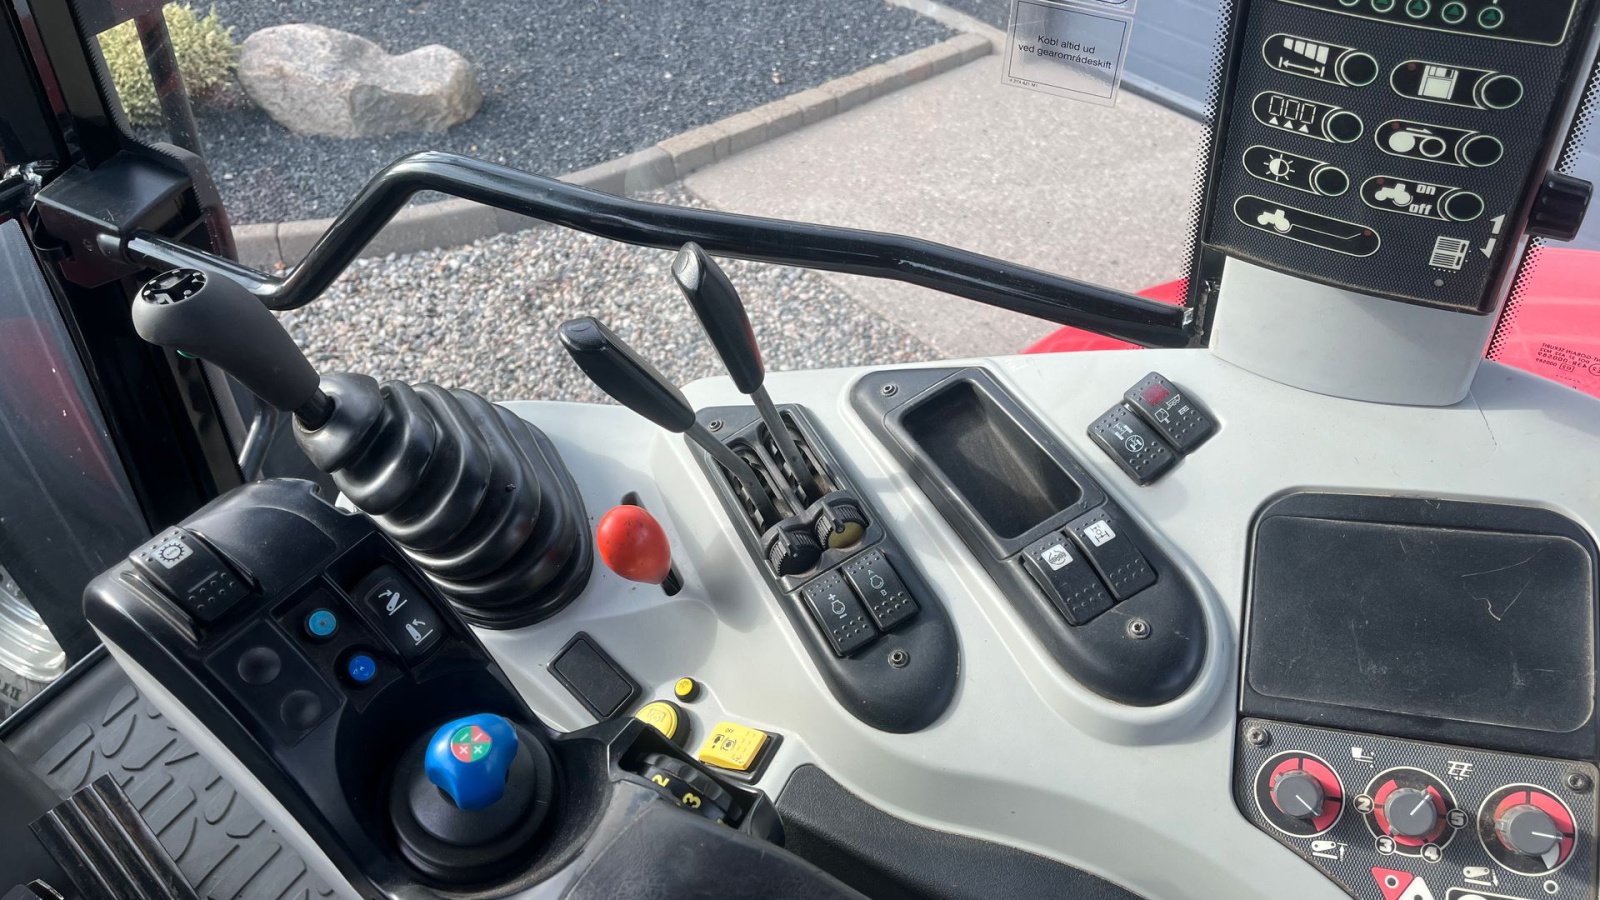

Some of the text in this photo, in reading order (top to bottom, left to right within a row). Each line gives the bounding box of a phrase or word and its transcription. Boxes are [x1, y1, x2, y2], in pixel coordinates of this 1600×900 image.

[1018, 43, 1035, 53] ved
[1037, 35, 1096, 54] Kobl altid ud
[1416, 183, 1436, 196] on
[1409, 202, 1433, 216] off
[652, 774, 670, 788] 2
[682, 792, 702, 809] 3
[1357, 798, 1370, 810] 2
[1451, 811, 1465, 826] 5
[1379, 840, 1393, 853] 3
[1424, 847, 1438, 860] 4
